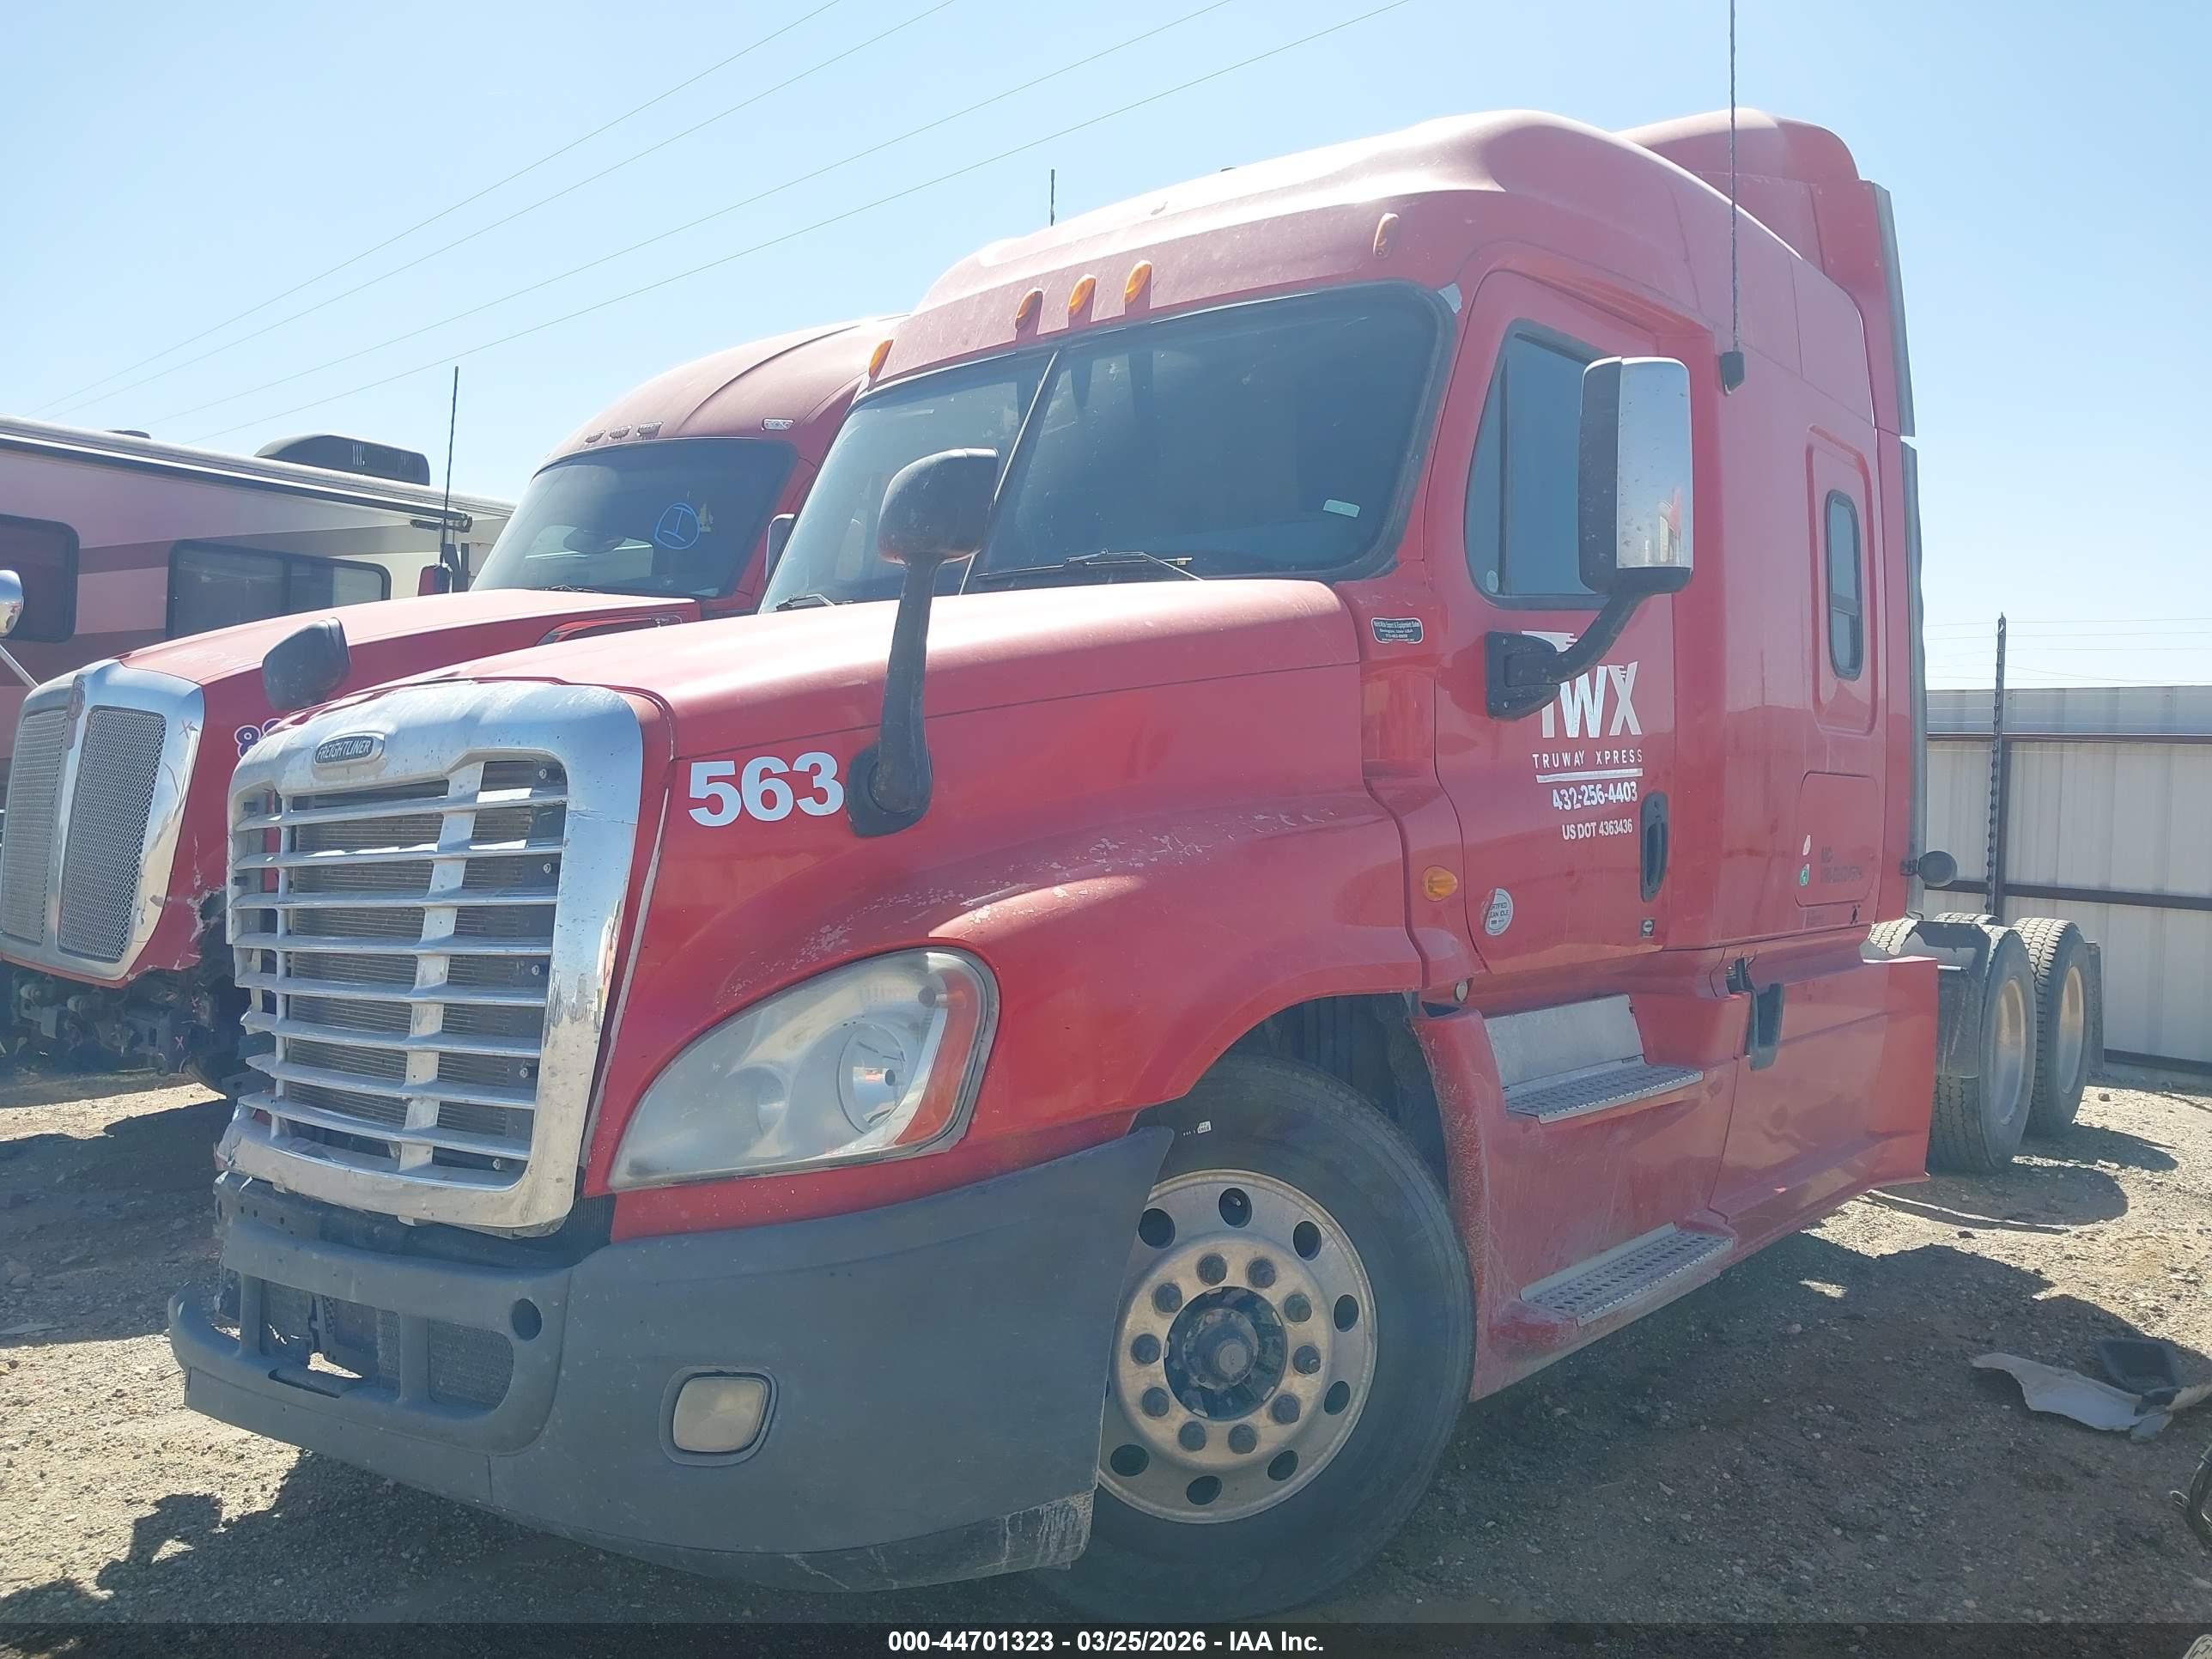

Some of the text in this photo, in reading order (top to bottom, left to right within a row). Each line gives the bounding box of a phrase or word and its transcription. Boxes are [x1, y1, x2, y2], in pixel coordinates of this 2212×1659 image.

[316, 738, 372, 761] FREIGHTLINER
[1532, 748, 1643, 769] TRUWAY XPRESS
[688, 751, 845, 827] 563
[1552, 781, 1638, 811] 432-256-4403
[1562, 817, 1633, 841] US DOT 4363436
